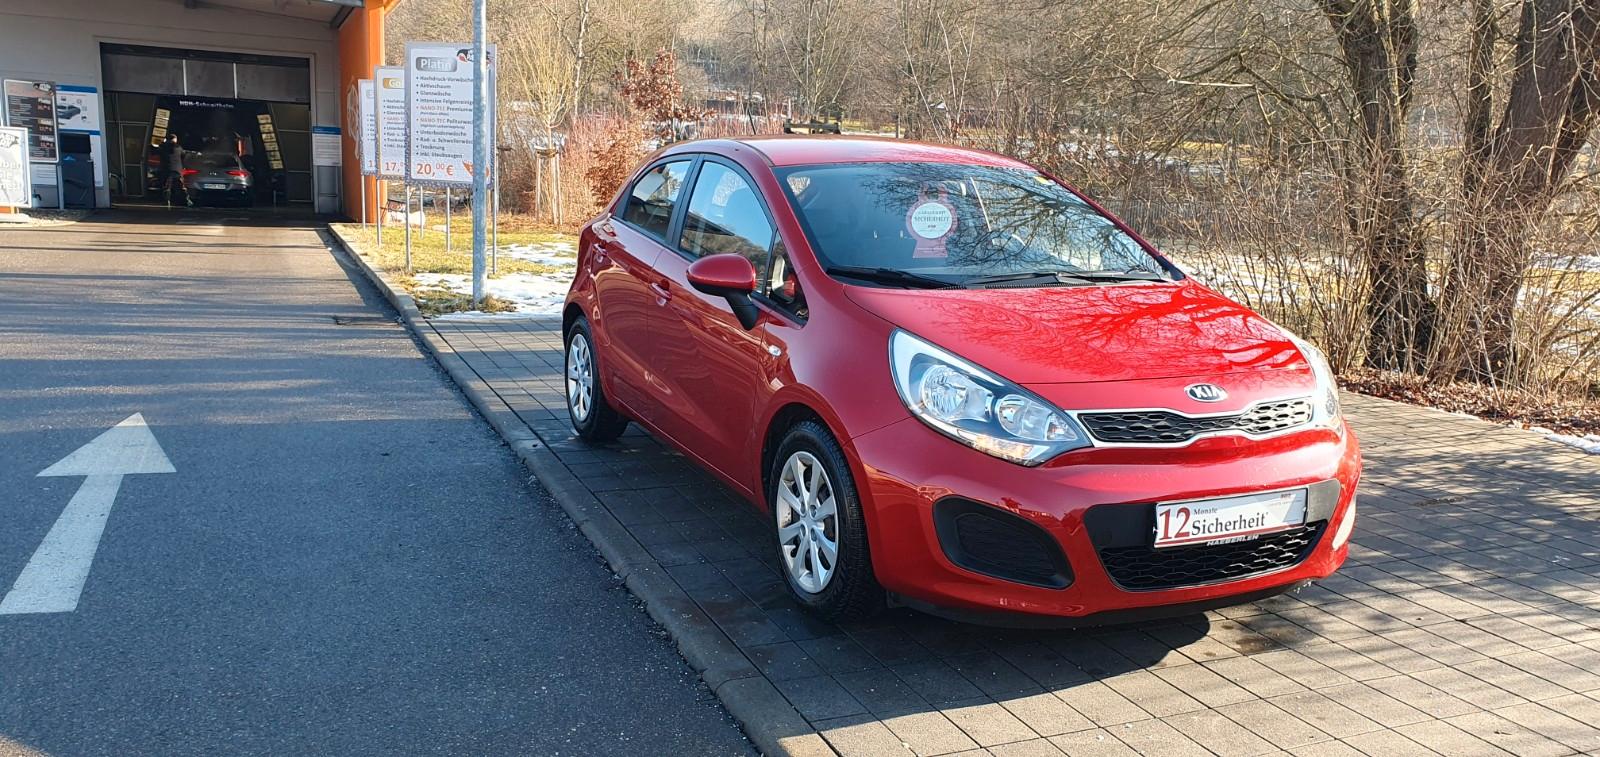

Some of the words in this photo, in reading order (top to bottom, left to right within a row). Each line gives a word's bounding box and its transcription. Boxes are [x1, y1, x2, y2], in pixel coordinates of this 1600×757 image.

[421, 58, 452, 69] Platin
[1192, 385, 1221, 398] KIA
[1194, 508, 1218, 516] Monate
[1158, 507, 1191, 541] 12
